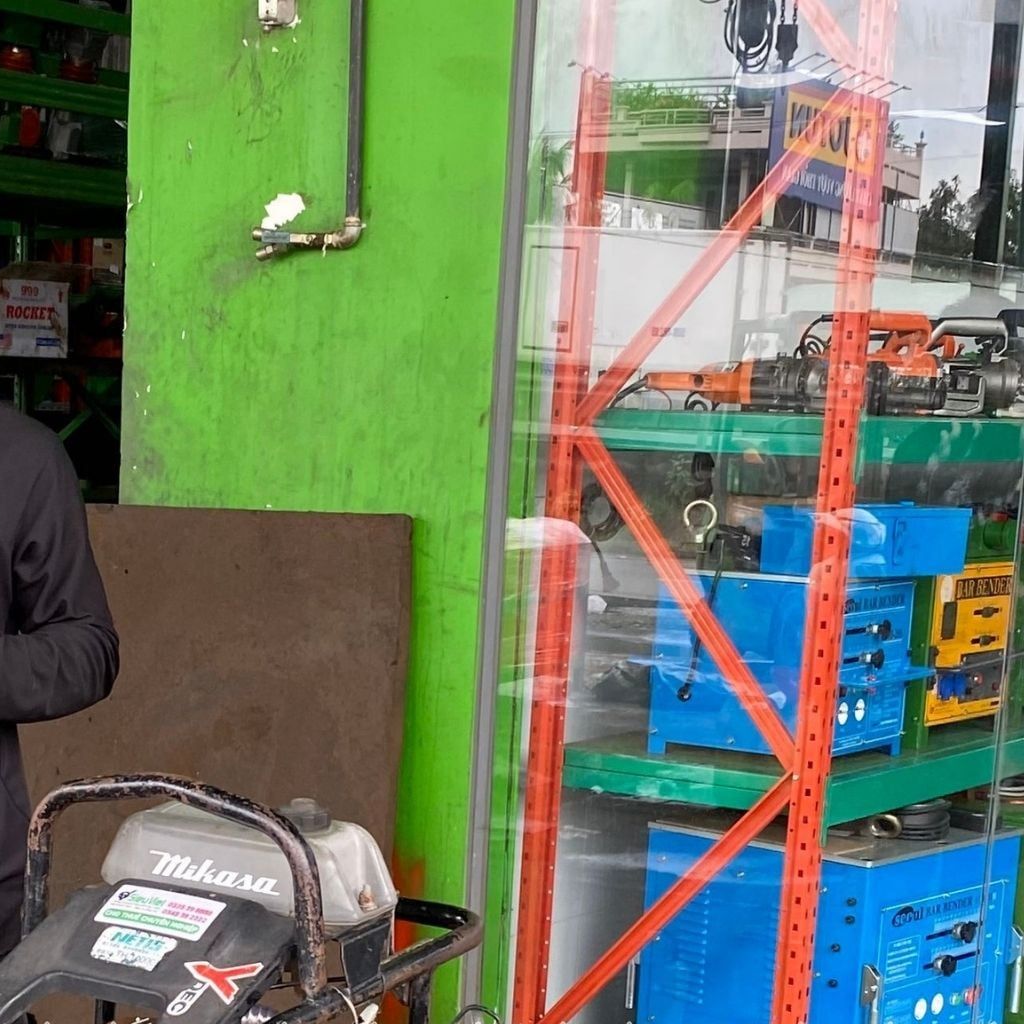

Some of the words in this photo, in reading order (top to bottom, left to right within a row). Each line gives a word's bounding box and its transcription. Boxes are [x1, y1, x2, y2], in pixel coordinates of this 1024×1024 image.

[5, 305, 56, 320] ROCKET
[956, 580, 976, 599] BAR
[149, 849, 281, 896] Mikasa
